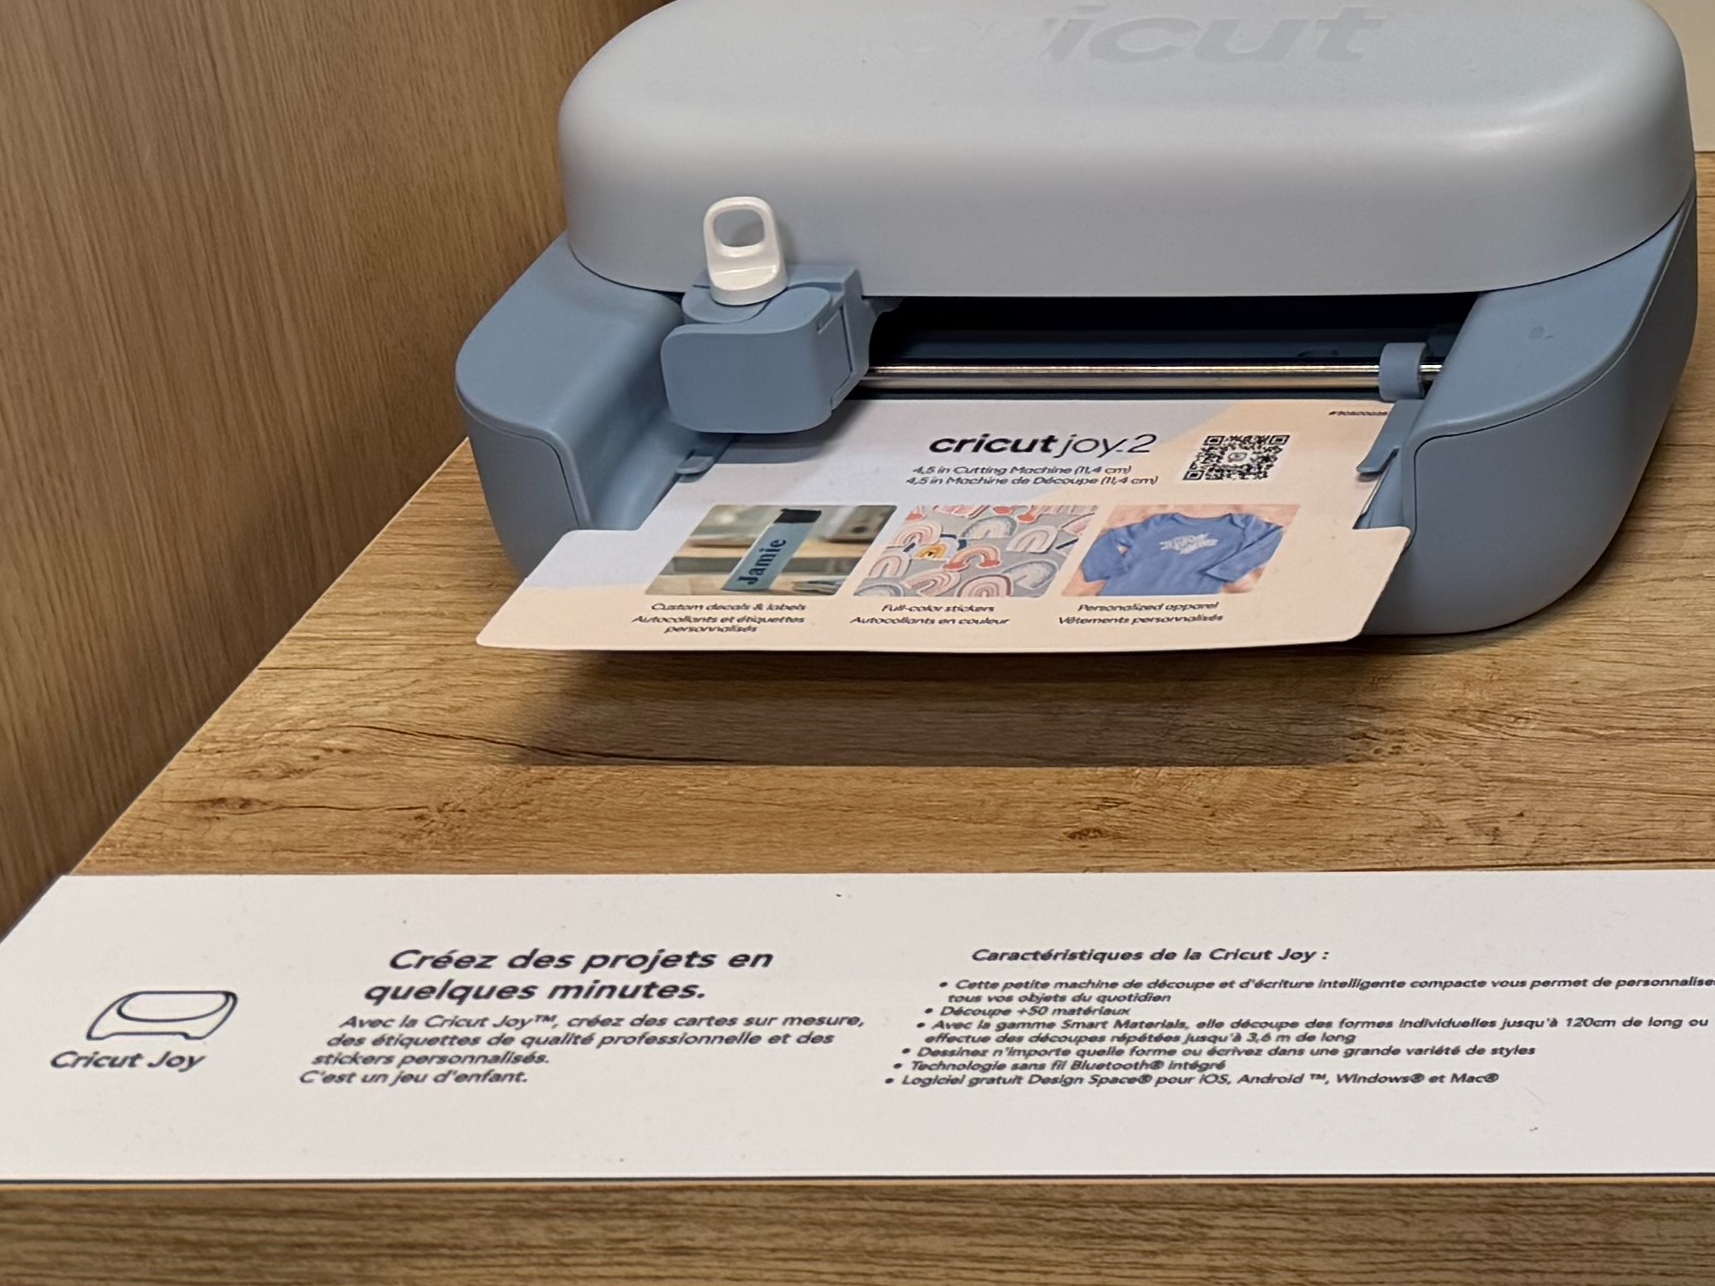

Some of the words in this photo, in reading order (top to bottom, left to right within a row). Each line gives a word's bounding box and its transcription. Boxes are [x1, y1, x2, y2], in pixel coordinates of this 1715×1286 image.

[929, 432, 1059, 454] cricut
[937, 466, 951, 474] in
[952, 465, 1008, 477] Cutting
[1009, 465, 1073, 475] Machine
[1104, 465, 1132, 475] cm)
[945, 476, 1009, 485] Machine
[1010, 476, 1031, 485] de
[1032, 476, 1099, 486] Découpe
[1130, 475, 1159, 486] cm)
[737, 539, 787, 586] Jamie
[650, 602, 704, 611] Custom
[705, 603, 751, 611] decals
[752, 603, 764, 611] &
[765, 603, 807, 611] labels
[881, 604, 944, 612] Full-color
[944, 604, 995, 613] stickers
[1077, 602, 1165, 612] Personalized
[1164, 601, 1220, 612] apparel
[631, 615, 718, 624] Autocollants
[719, 616, 736, 624] et
[736, 615, 805, 625] étiquettes
[849, 616, 936, 625] Autocollants
[958, 616, 1010, 625] couleur
[1058, 616, 1130, 625] Vêtements
[1130, 613, 1224, 626] personnalisés
[663, 624, 758, 634] personnalisés
[389, 949, 499, 970] Créez
[507, 947, 576, 969] des
[579, 948, 718, 975] projets
[727, 953, 774, 968] en
[971, 948, 1144, 964] Caractéristiques
[1149, 947, 1178, 961] de
[1183, 947, 1202, 961] la
[1208, 947, 1273, 961] Cricut
[1277, 947, 1317, 964] Joy
[364, 978, 539, 1006] quelques
[547, 979, 705, 1000] minutes.
[939, 1005, 1013, 1019] Découpe
[50, 1050, 144, 1069] Cricut
[146, 1050, 206, 1073] Joy
